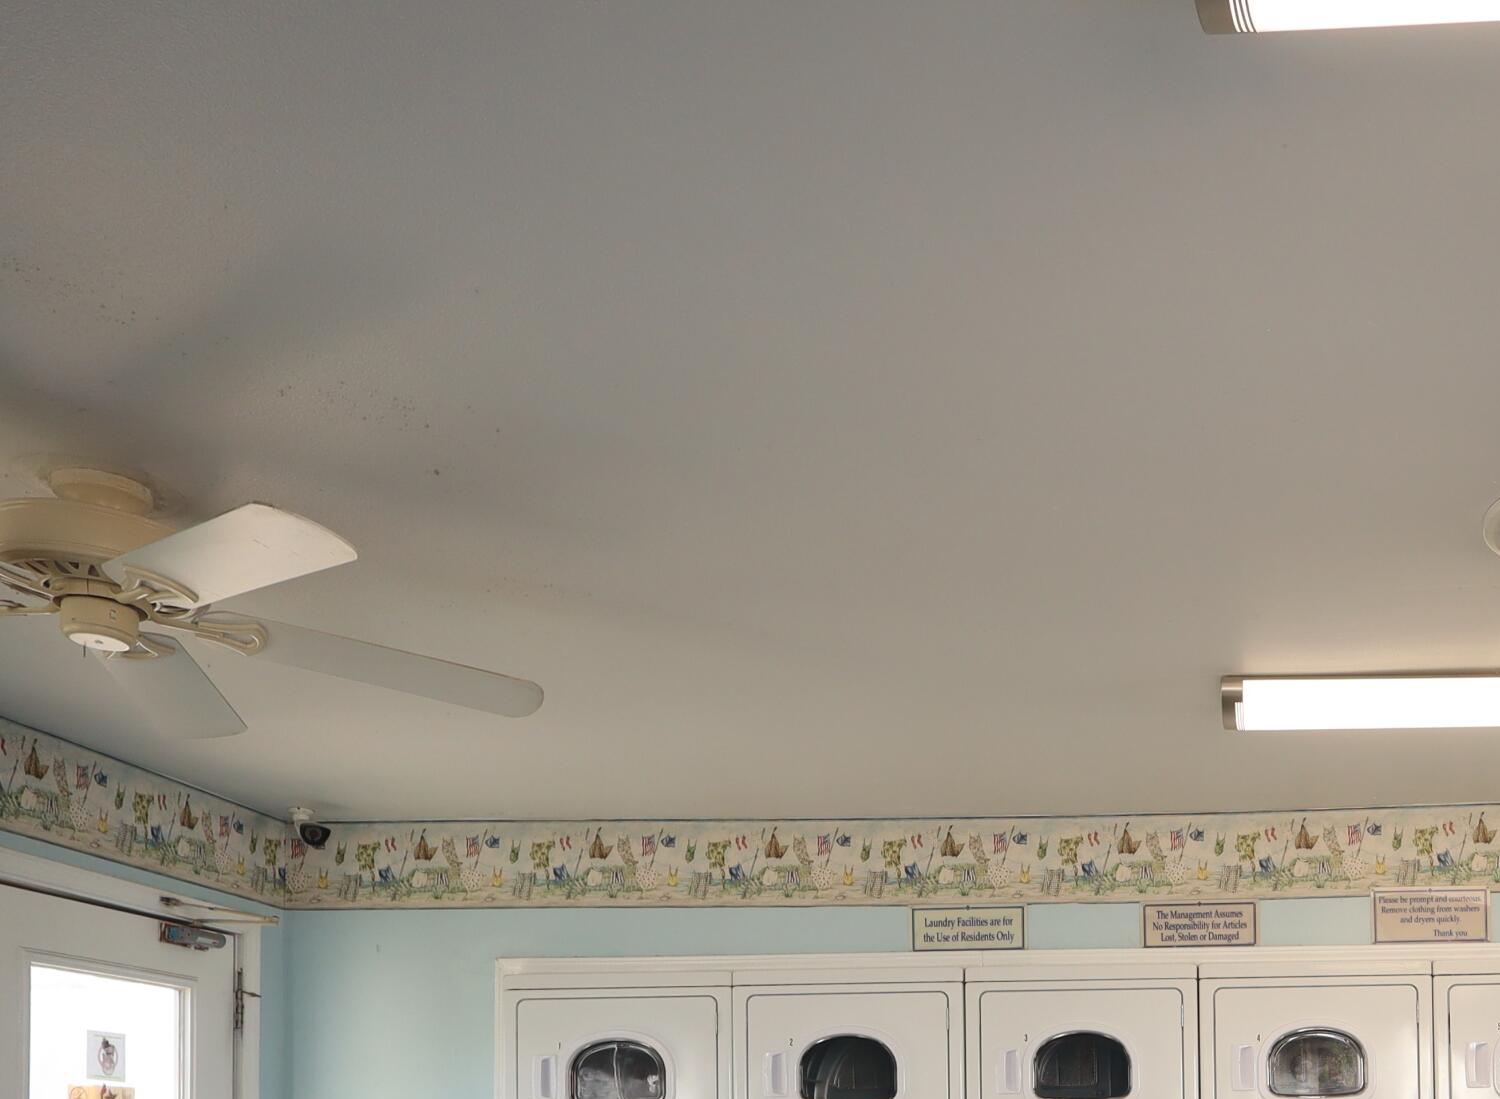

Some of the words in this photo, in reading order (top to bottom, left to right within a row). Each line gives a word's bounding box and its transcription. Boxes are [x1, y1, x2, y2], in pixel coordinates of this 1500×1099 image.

[1379, 896, 1398, 904] Please
[1410, 896, 1433, 904] prompt
[1409, 906, 1435, 914] clothing
[1157, 911, 1168, 919] The
[1170, 910, 1212, 921] Management
[1215, 910, 1243, 918] Assumes
[1414, 916, 1435, 925] dryers
[925, 918, 955, 930] Laundry
[958, 917, 988, 926] Facilities
[1003, 916, 1013, 925] for
[1153, 922, 1163, 931] No
[1165, 921, 1209, 933] Responsibility
[1212, 920, 1221, 929] for
[1223, 920, 1247, 929] Articles
[924, 933, 934, 942] the
[937, 932, 950, 942] Use
[952, 933, 959, 941] of
[961, 932, 995, 941] Residents
[997, 931, 1014, 944] Only
[1161, 933, 1176, 943] Lost,
[1178, 932, 1198, 941] Stolen
[1208, 931, 1239, 943] Damaged
[789, 1038, 793, 1046] 2
[1257, 1034, 1261, 1042] 4
